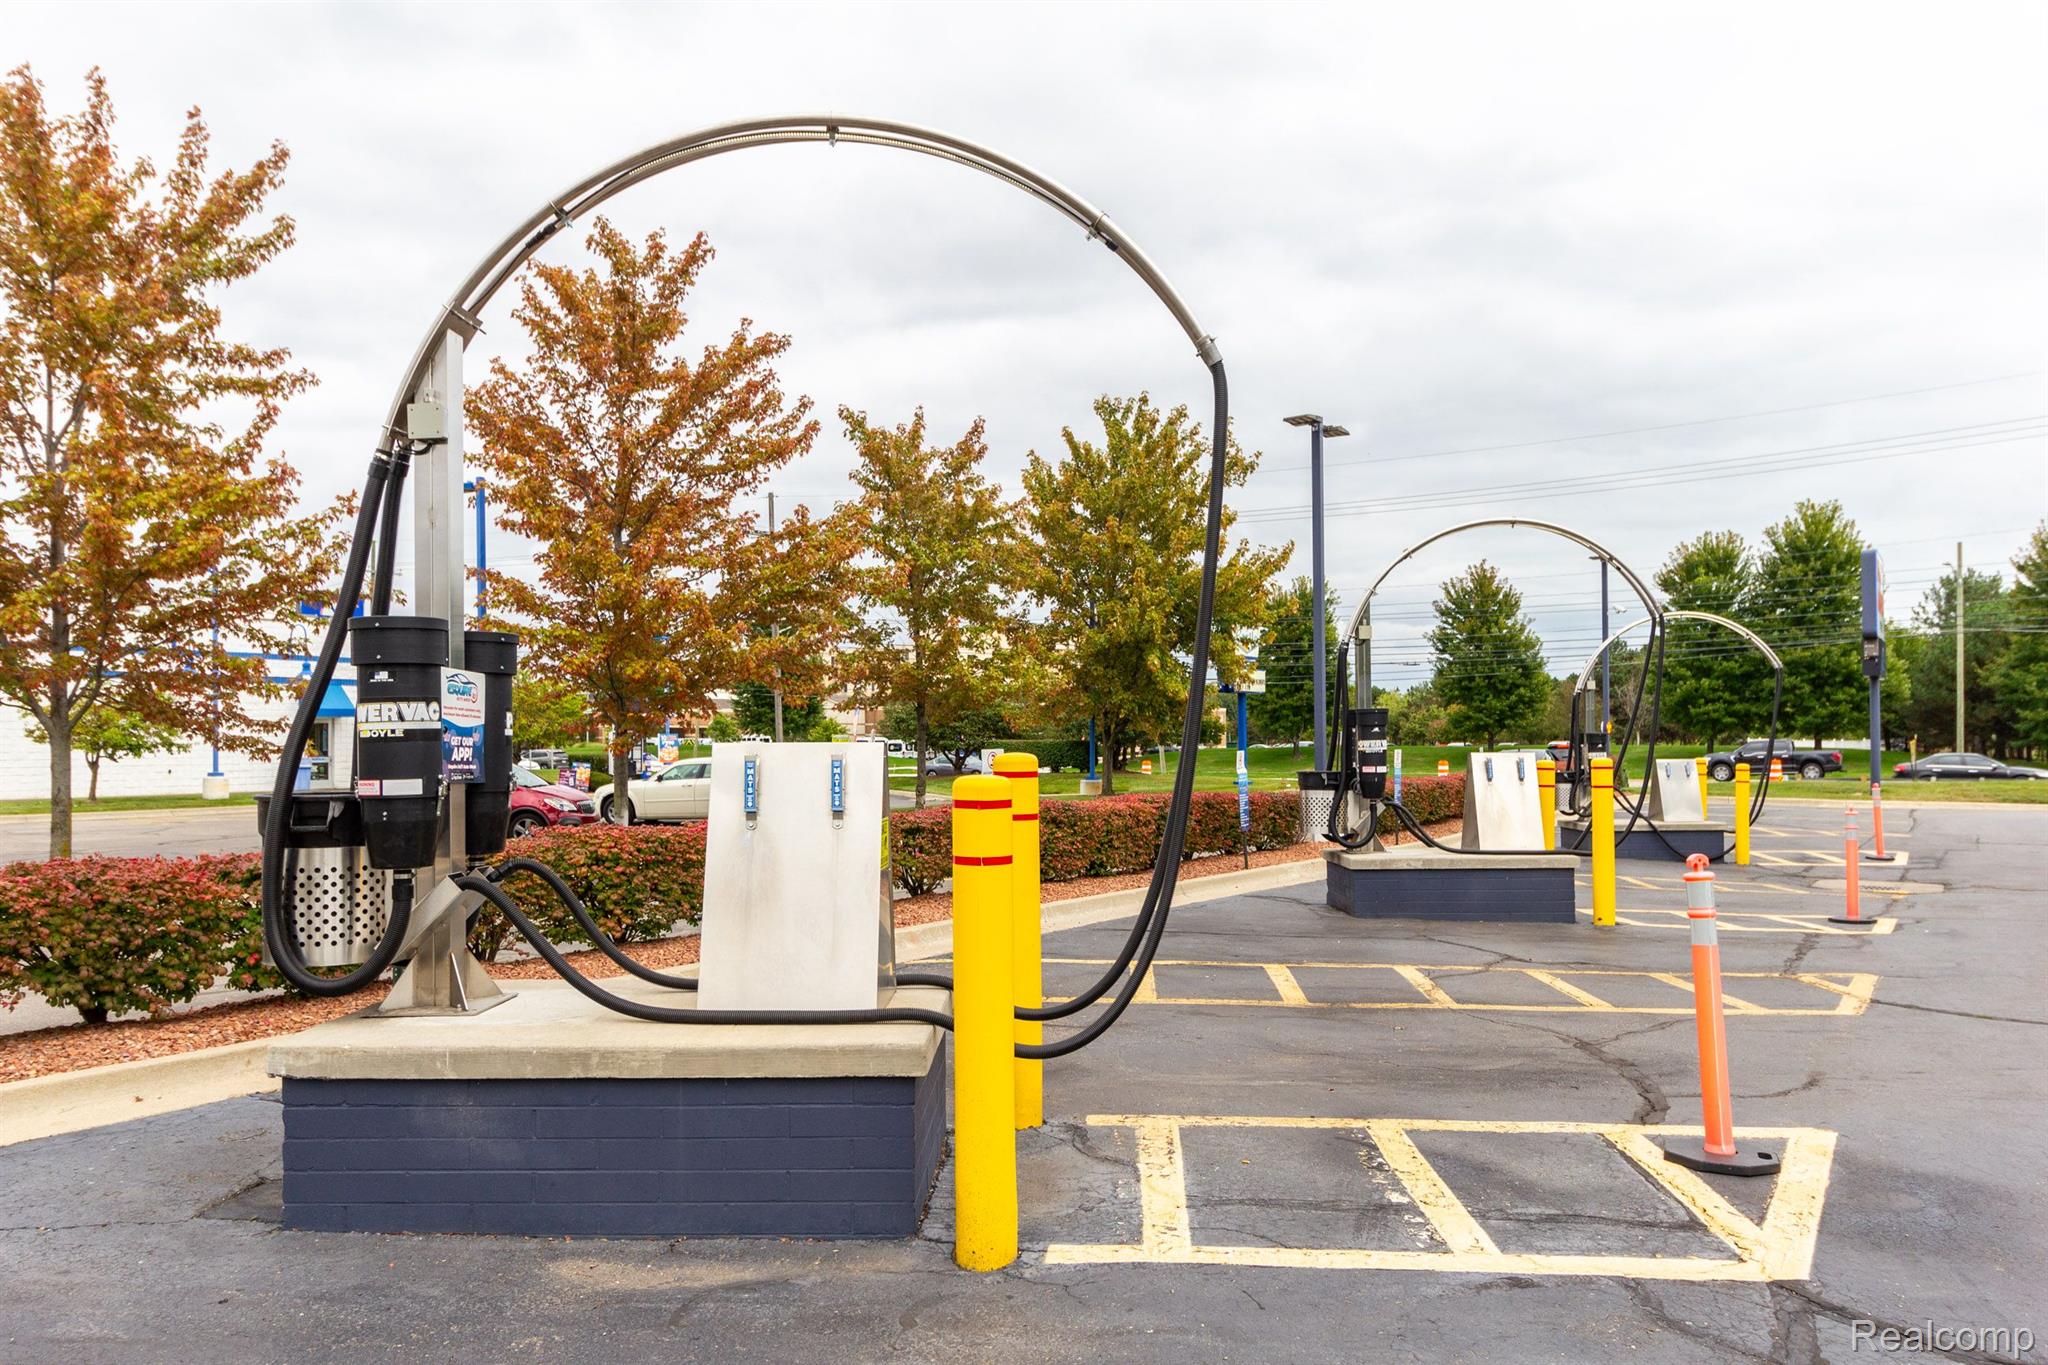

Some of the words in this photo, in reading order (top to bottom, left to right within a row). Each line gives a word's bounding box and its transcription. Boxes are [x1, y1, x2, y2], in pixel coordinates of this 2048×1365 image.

[450, 736, 461, 746] GET
[462, 736, 473, 747] OUR
[451, 747, 473, 761] APP!
